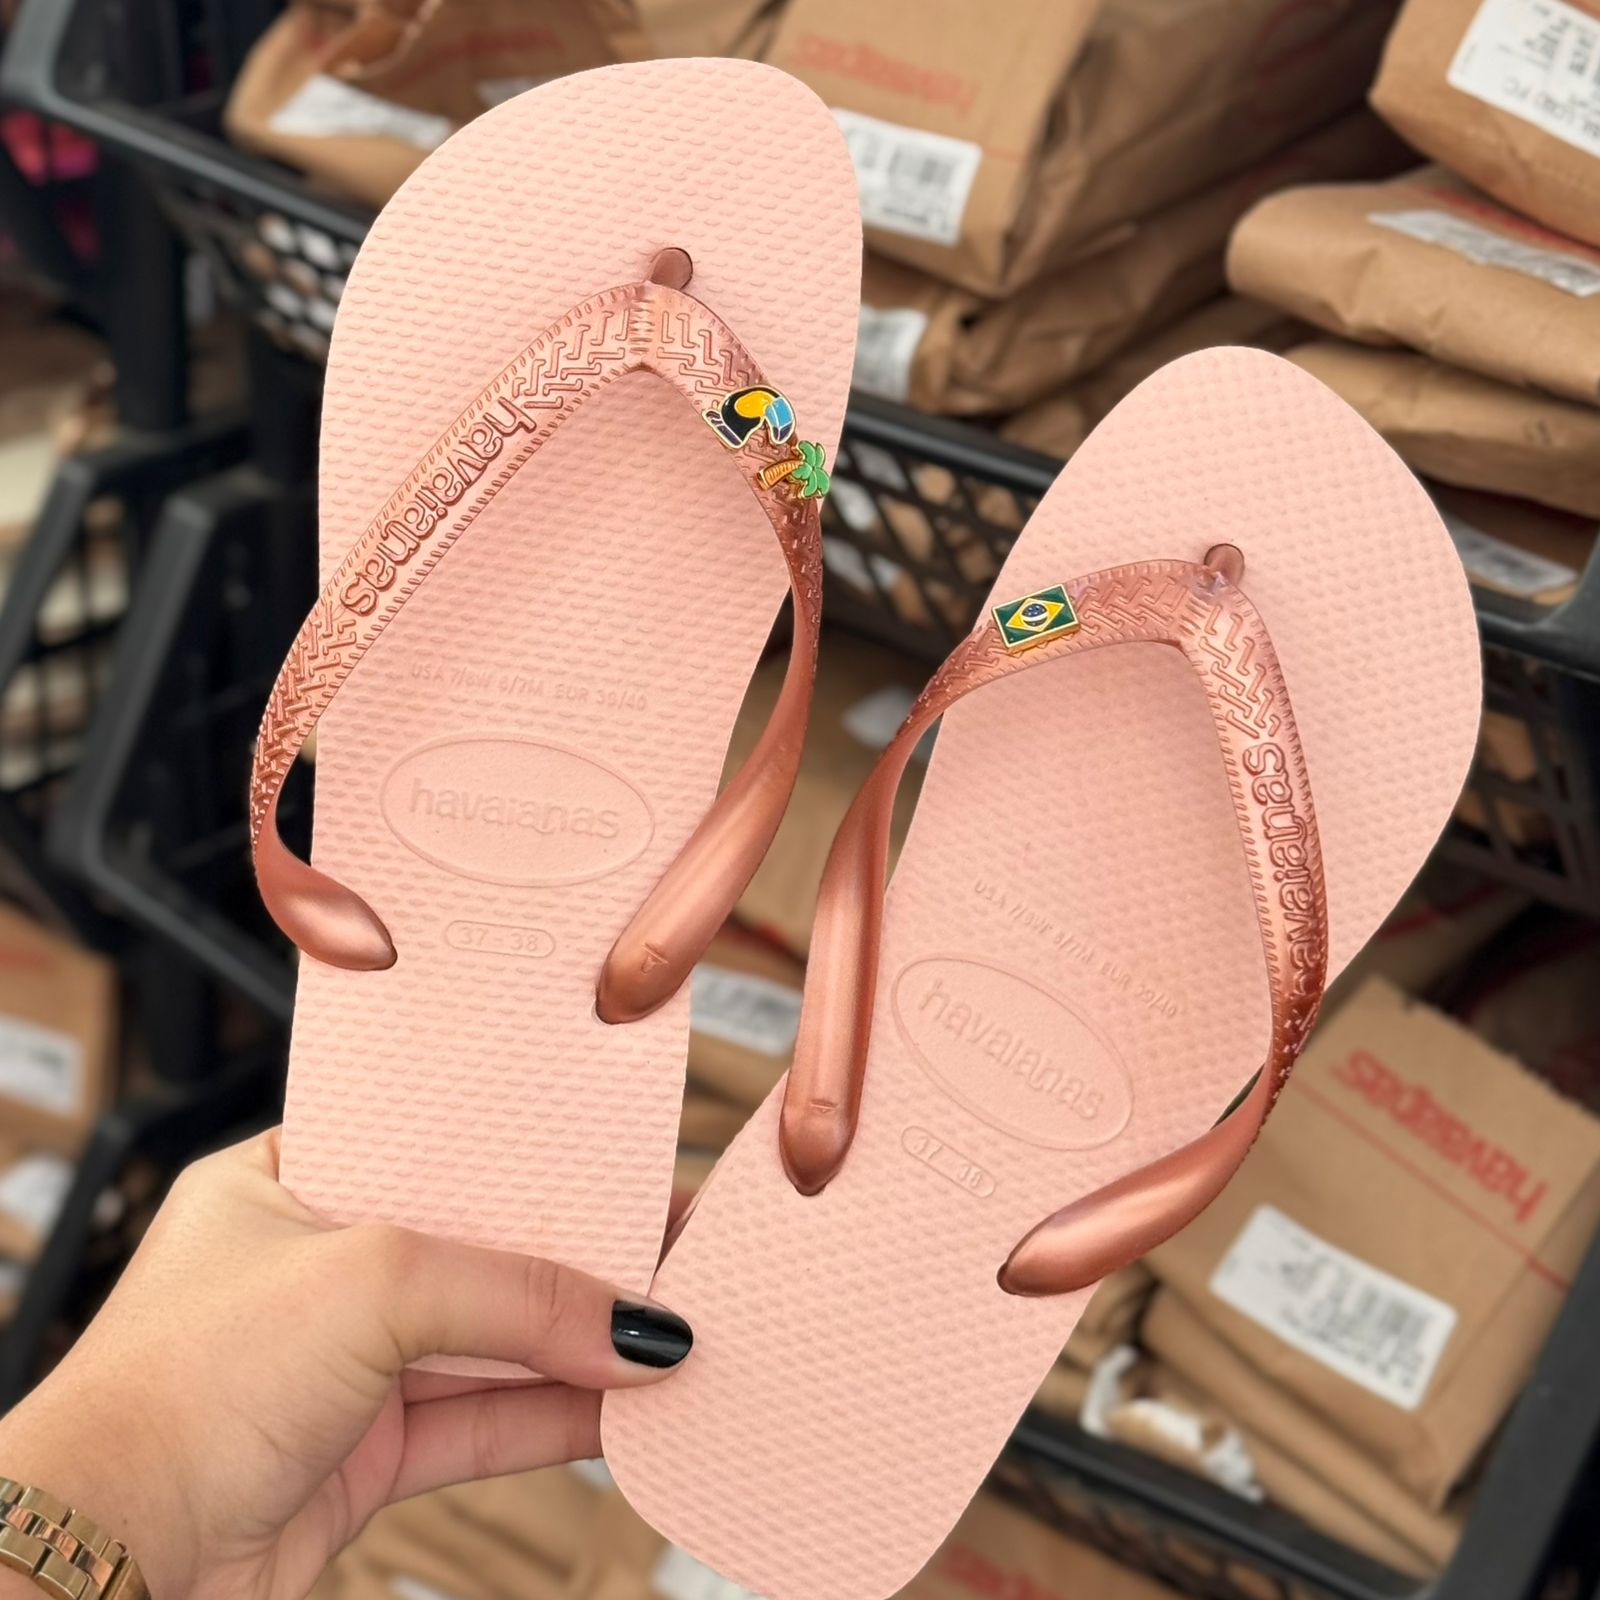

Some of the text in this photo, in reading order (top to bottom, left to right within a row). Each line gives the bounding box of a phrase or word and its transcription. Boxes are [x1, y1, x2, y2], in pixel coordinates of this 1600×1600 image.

[341, 396, 536, 617] havaianas
[411, 663, 444, 682] USA
[555, 684, 588, 703] EUR
[409, 777, 620, 839] havaianas
[459, 926, 488, 946] 37
[509, 931, 538, 952] 38
[919, 978, 1105, 1120] havaianas
